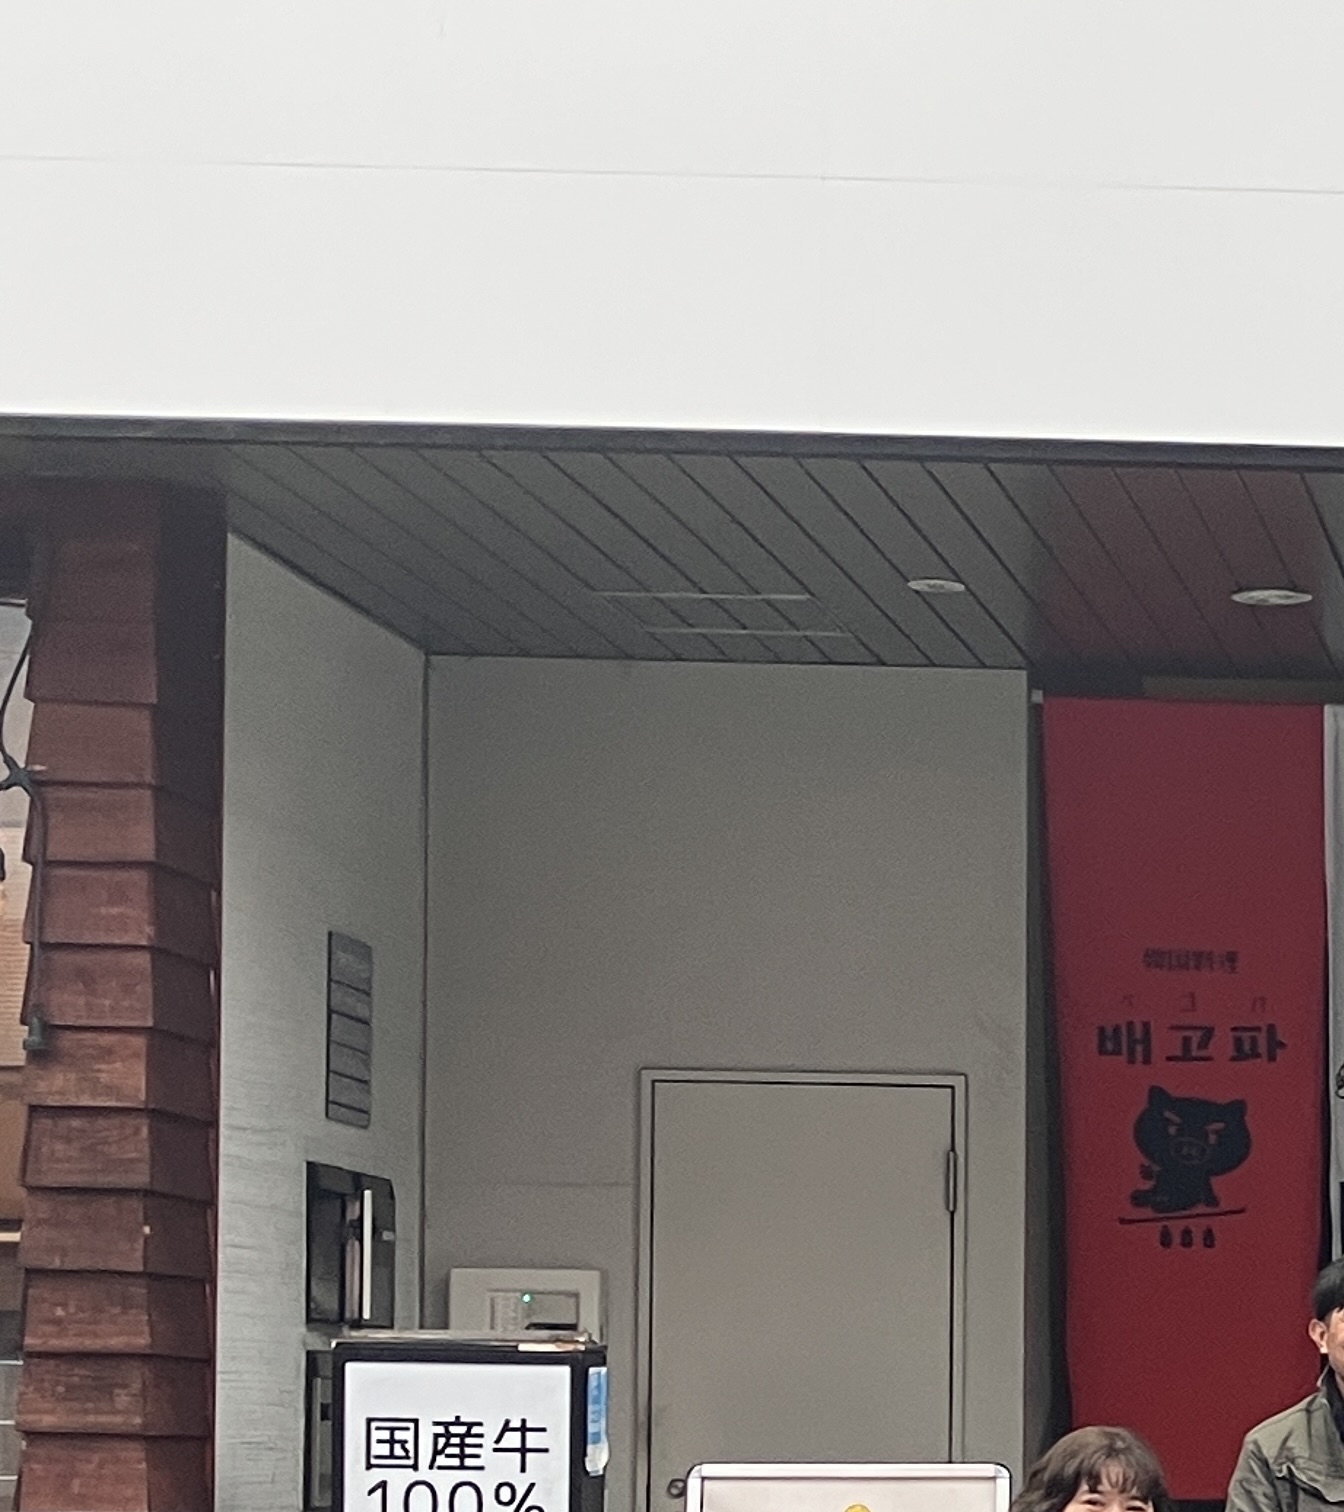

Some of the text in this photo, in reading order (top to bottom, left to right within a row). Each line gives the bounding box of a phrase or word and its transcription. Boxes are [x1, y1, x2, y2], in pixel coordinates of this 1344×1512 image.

[1097, 1020, 1288, 1066] 배고파
[364, 1415, 550, 1474] 国産牛
